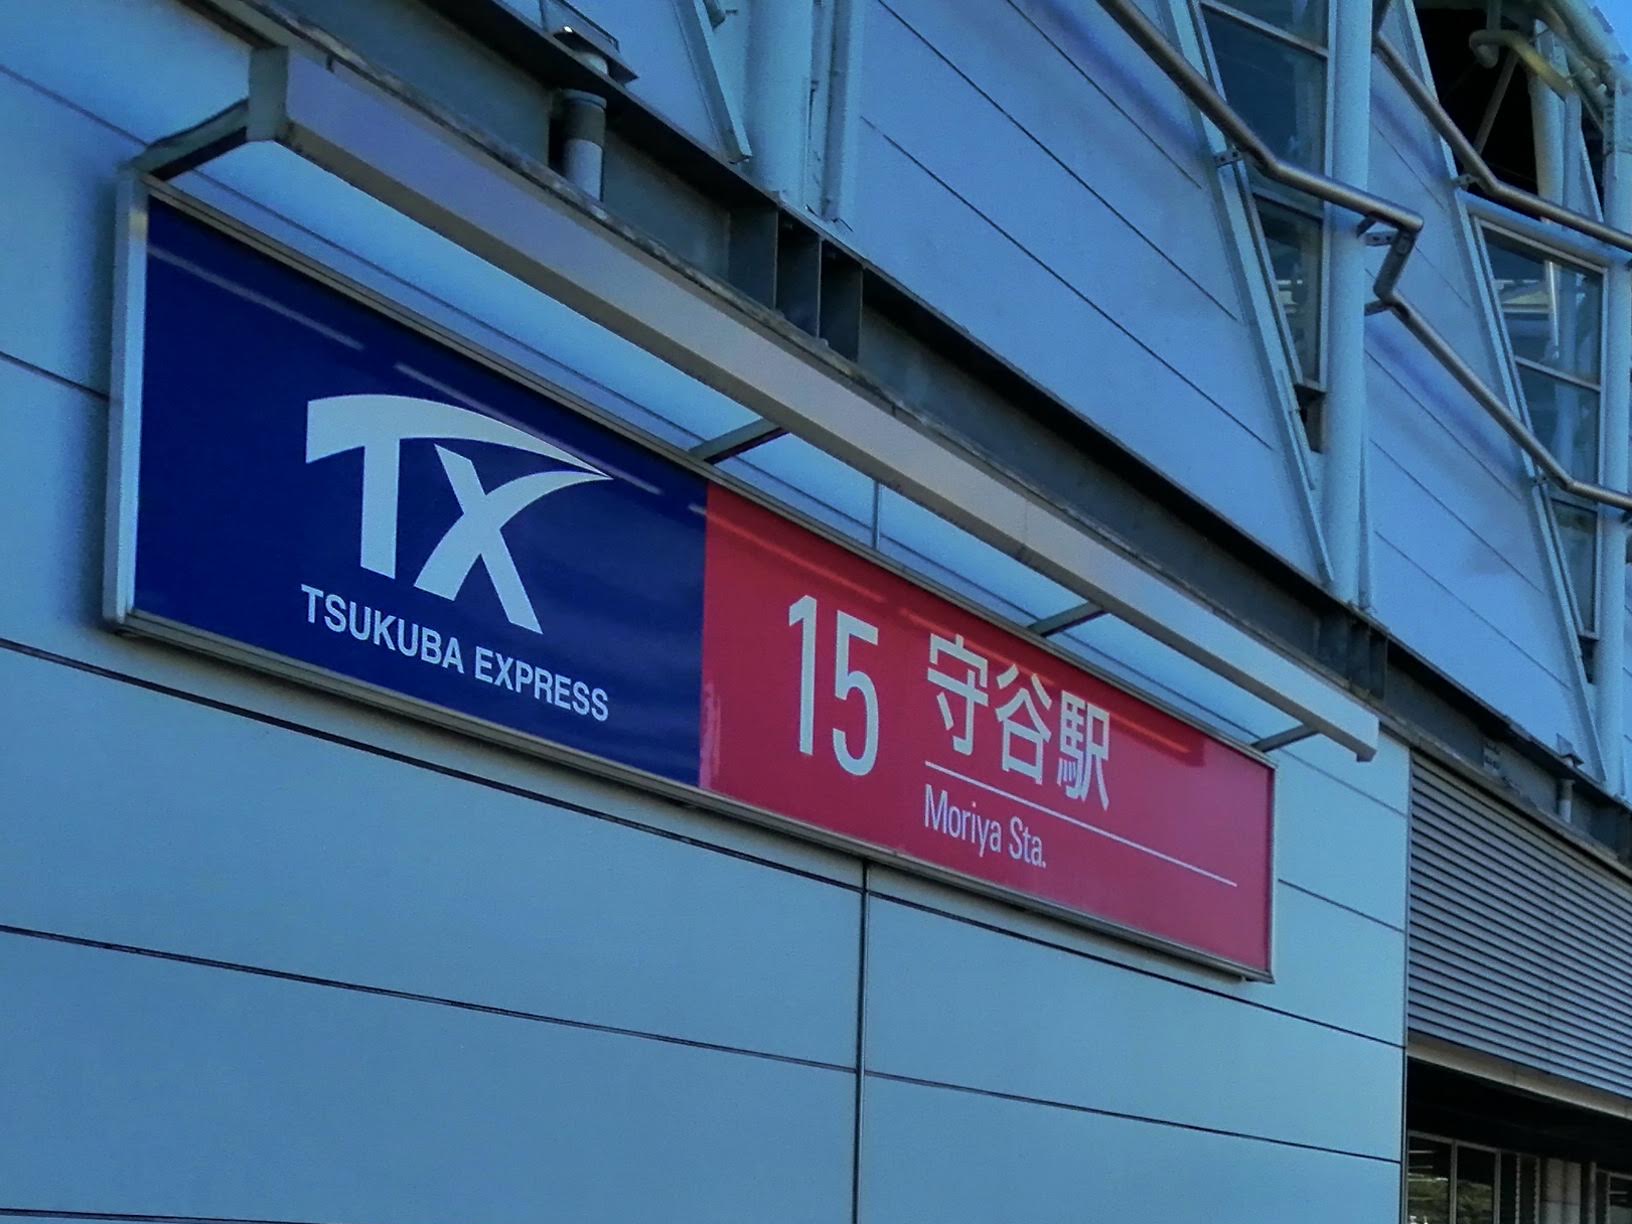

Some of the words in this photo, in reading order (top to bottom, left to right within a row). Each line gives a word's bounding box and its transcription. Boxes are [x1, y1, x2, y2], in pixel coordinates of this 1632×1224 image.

[305, 392, 612, 636] TX
[301, 584, 464, 674] TSUKUBA
[474, 647, 609, 722] EXPRESS
[787, 594, 880, 776] 15
[925, 632, 1112, 812] 守谷駅
[924, 785, 1003, 858] Moriya
[1008, 814, 1048, 870] Sta.
